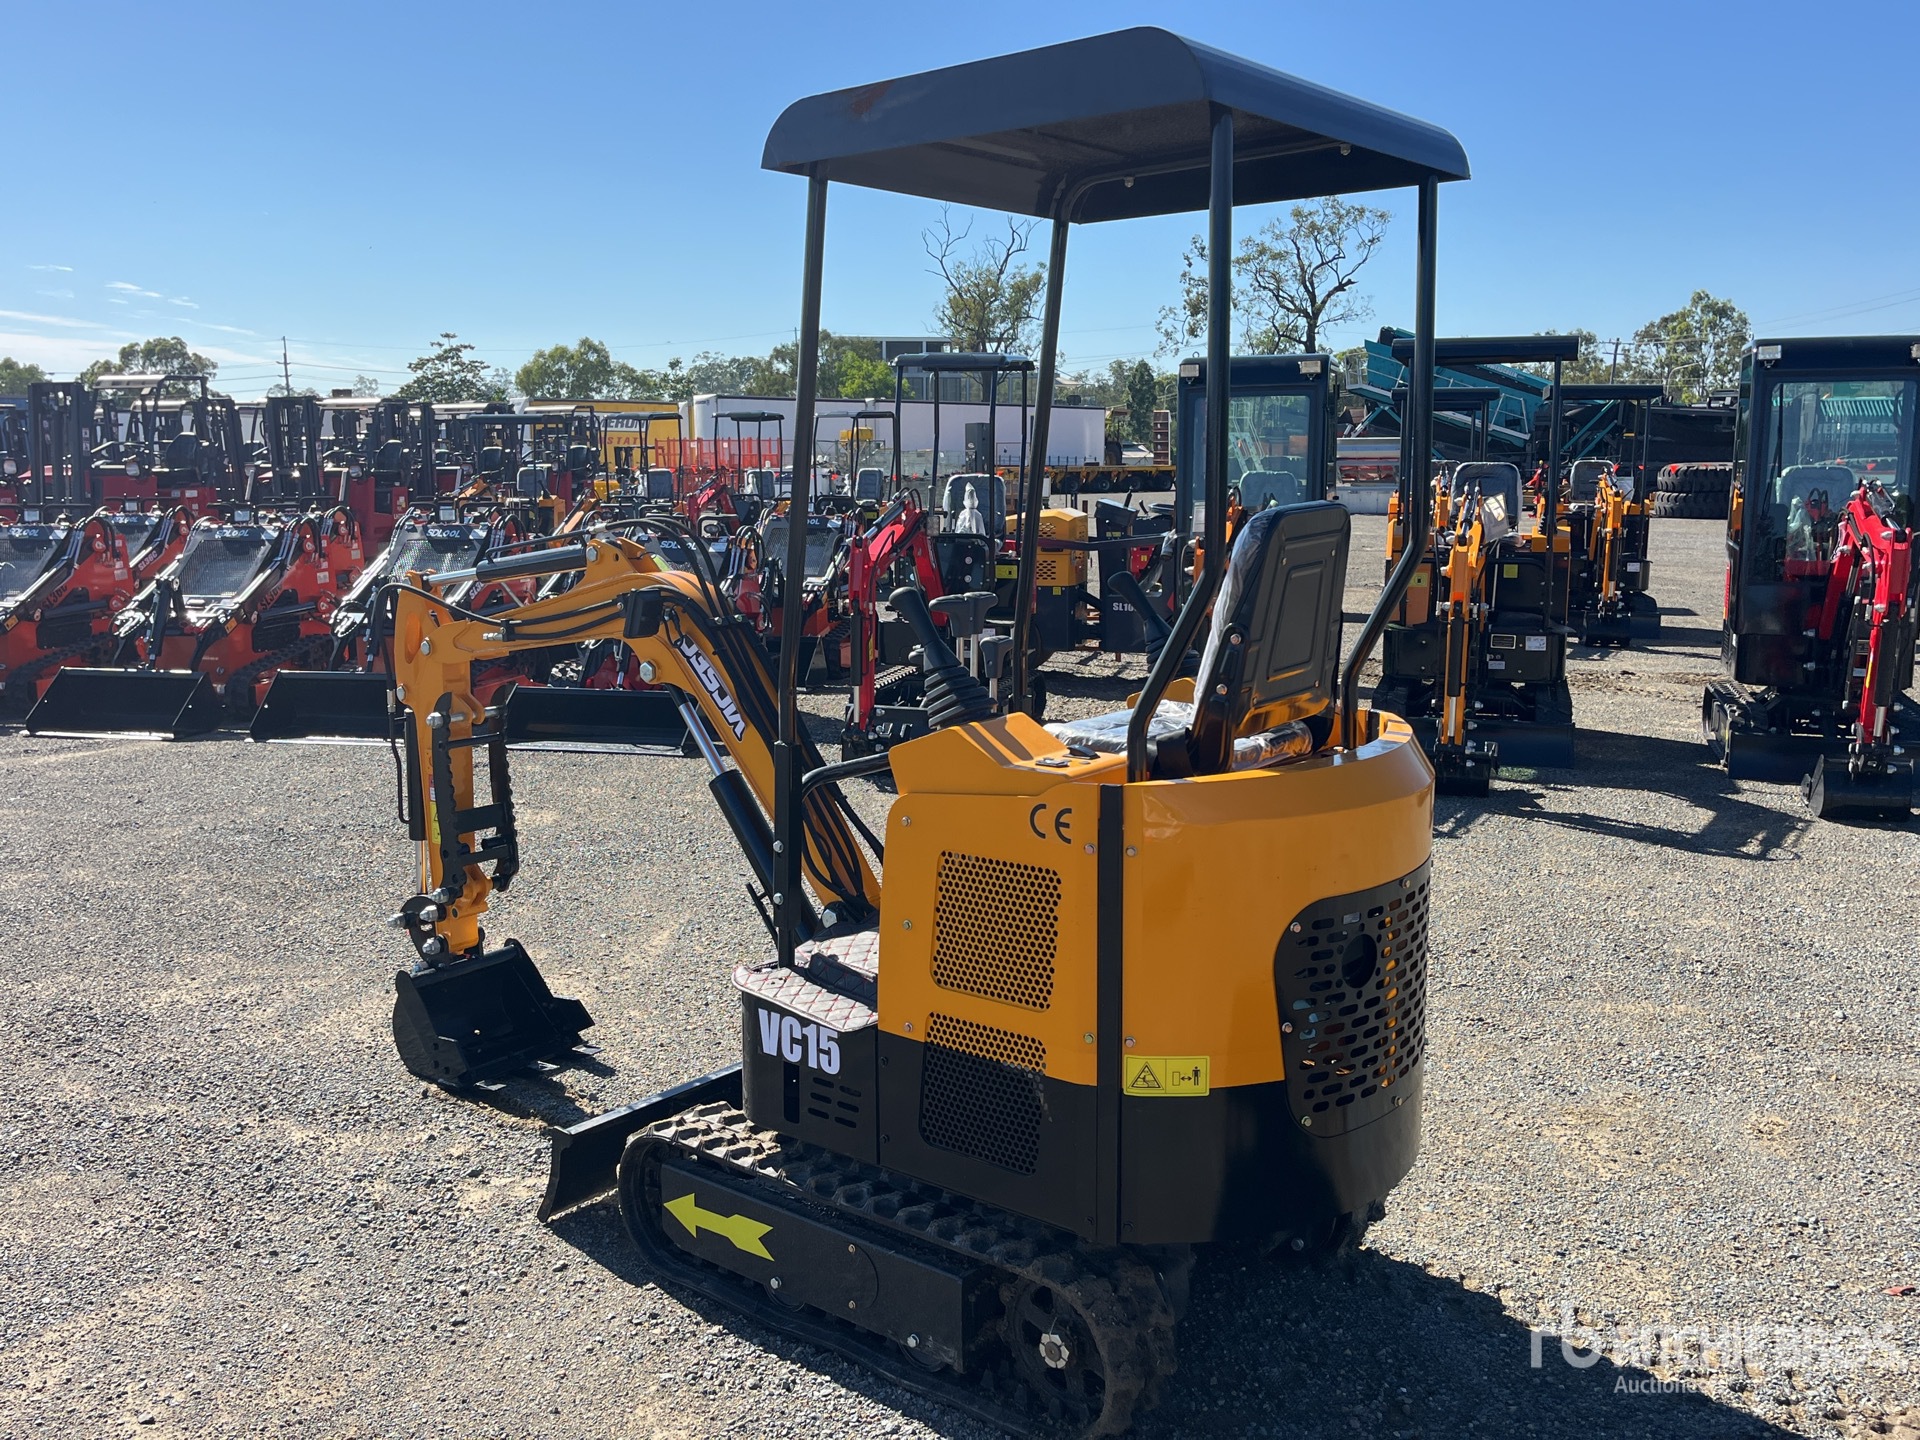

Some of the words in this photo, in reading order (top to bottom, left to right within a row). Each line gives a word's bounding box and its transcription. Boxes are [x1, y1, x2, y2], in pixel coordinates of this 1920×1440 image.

[426, 528, 461, 538] SDLOOL
[1029, 803, 1072, 845] CE
[758, 1008, 840, 1075] VC15
